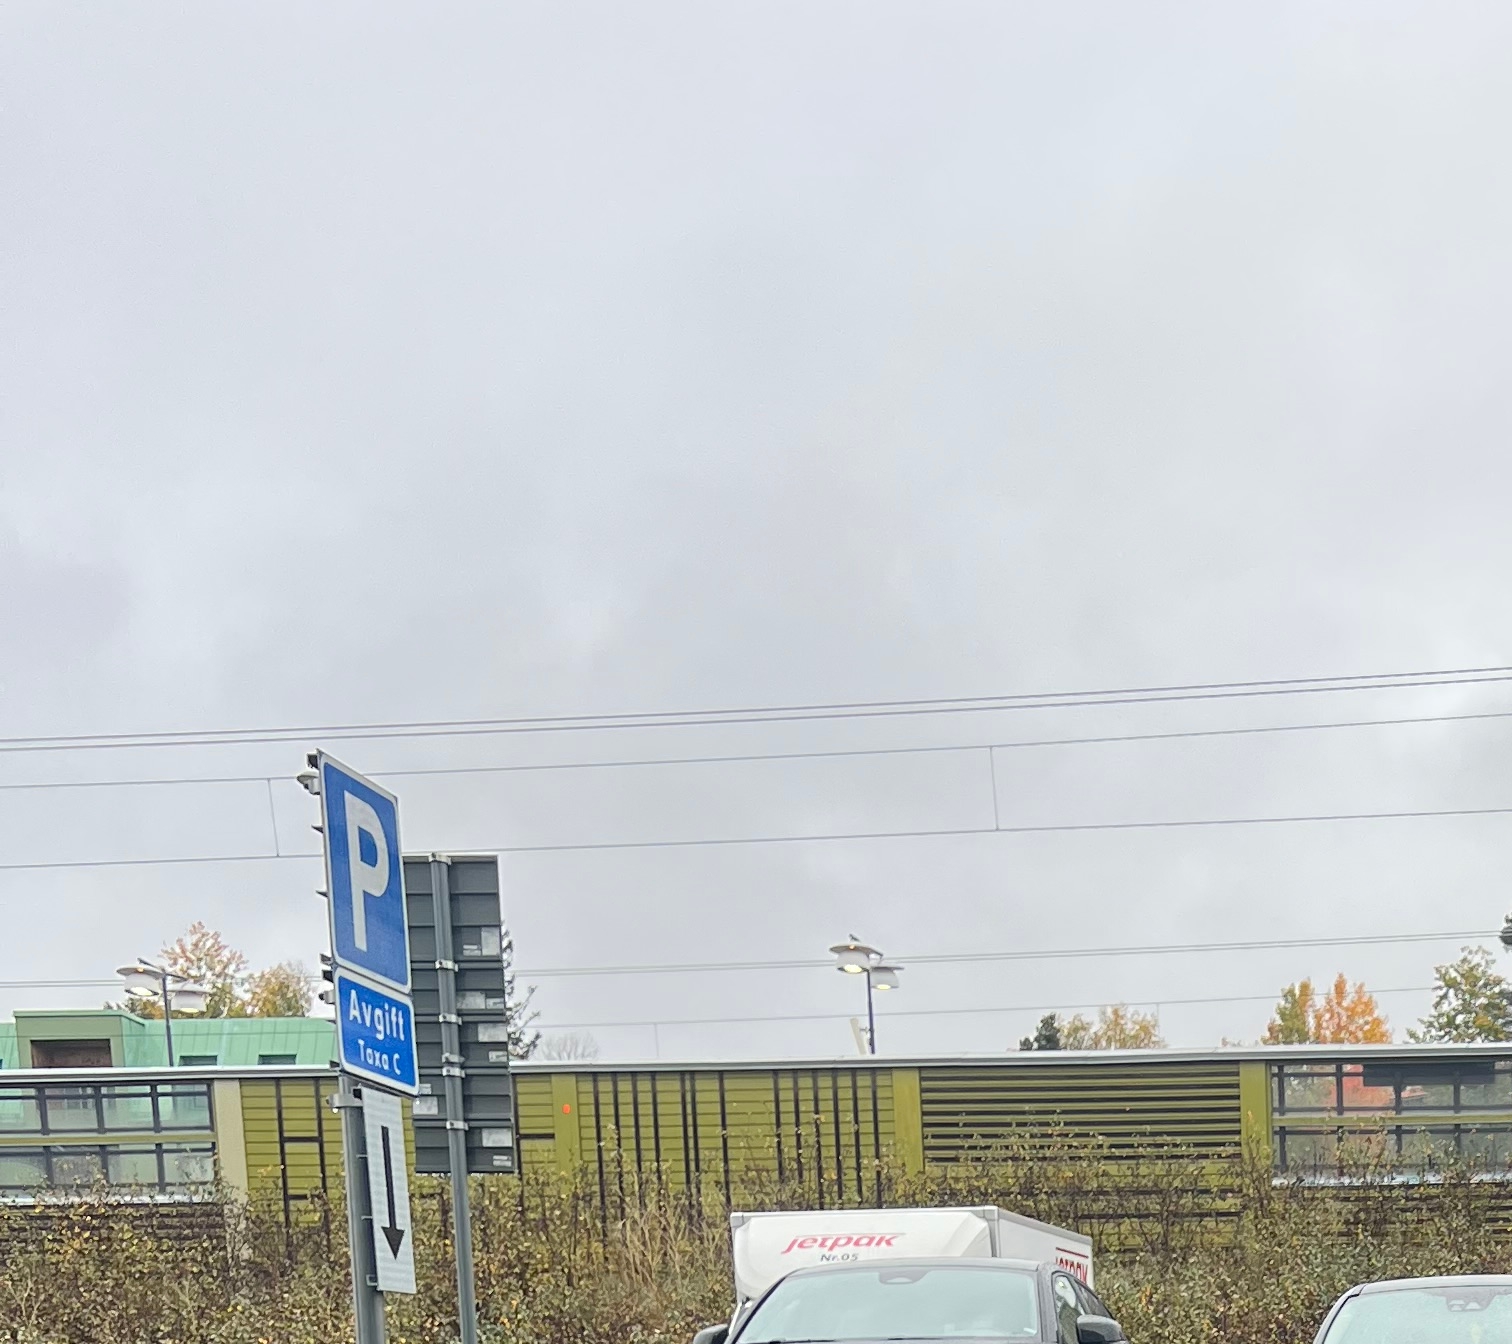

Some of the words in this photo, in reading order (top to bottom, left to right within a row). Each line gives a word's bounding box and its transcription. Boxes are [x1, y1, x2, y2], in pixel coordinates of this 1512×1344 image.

[342, 789, 391, 953] P
[348, 988, 405, 1041] Avgift
[357, 1038, 390, 1071] Taxa
[392, 1052, 401, 1076] C
[780, 1233, 899, 1255] jetpak
